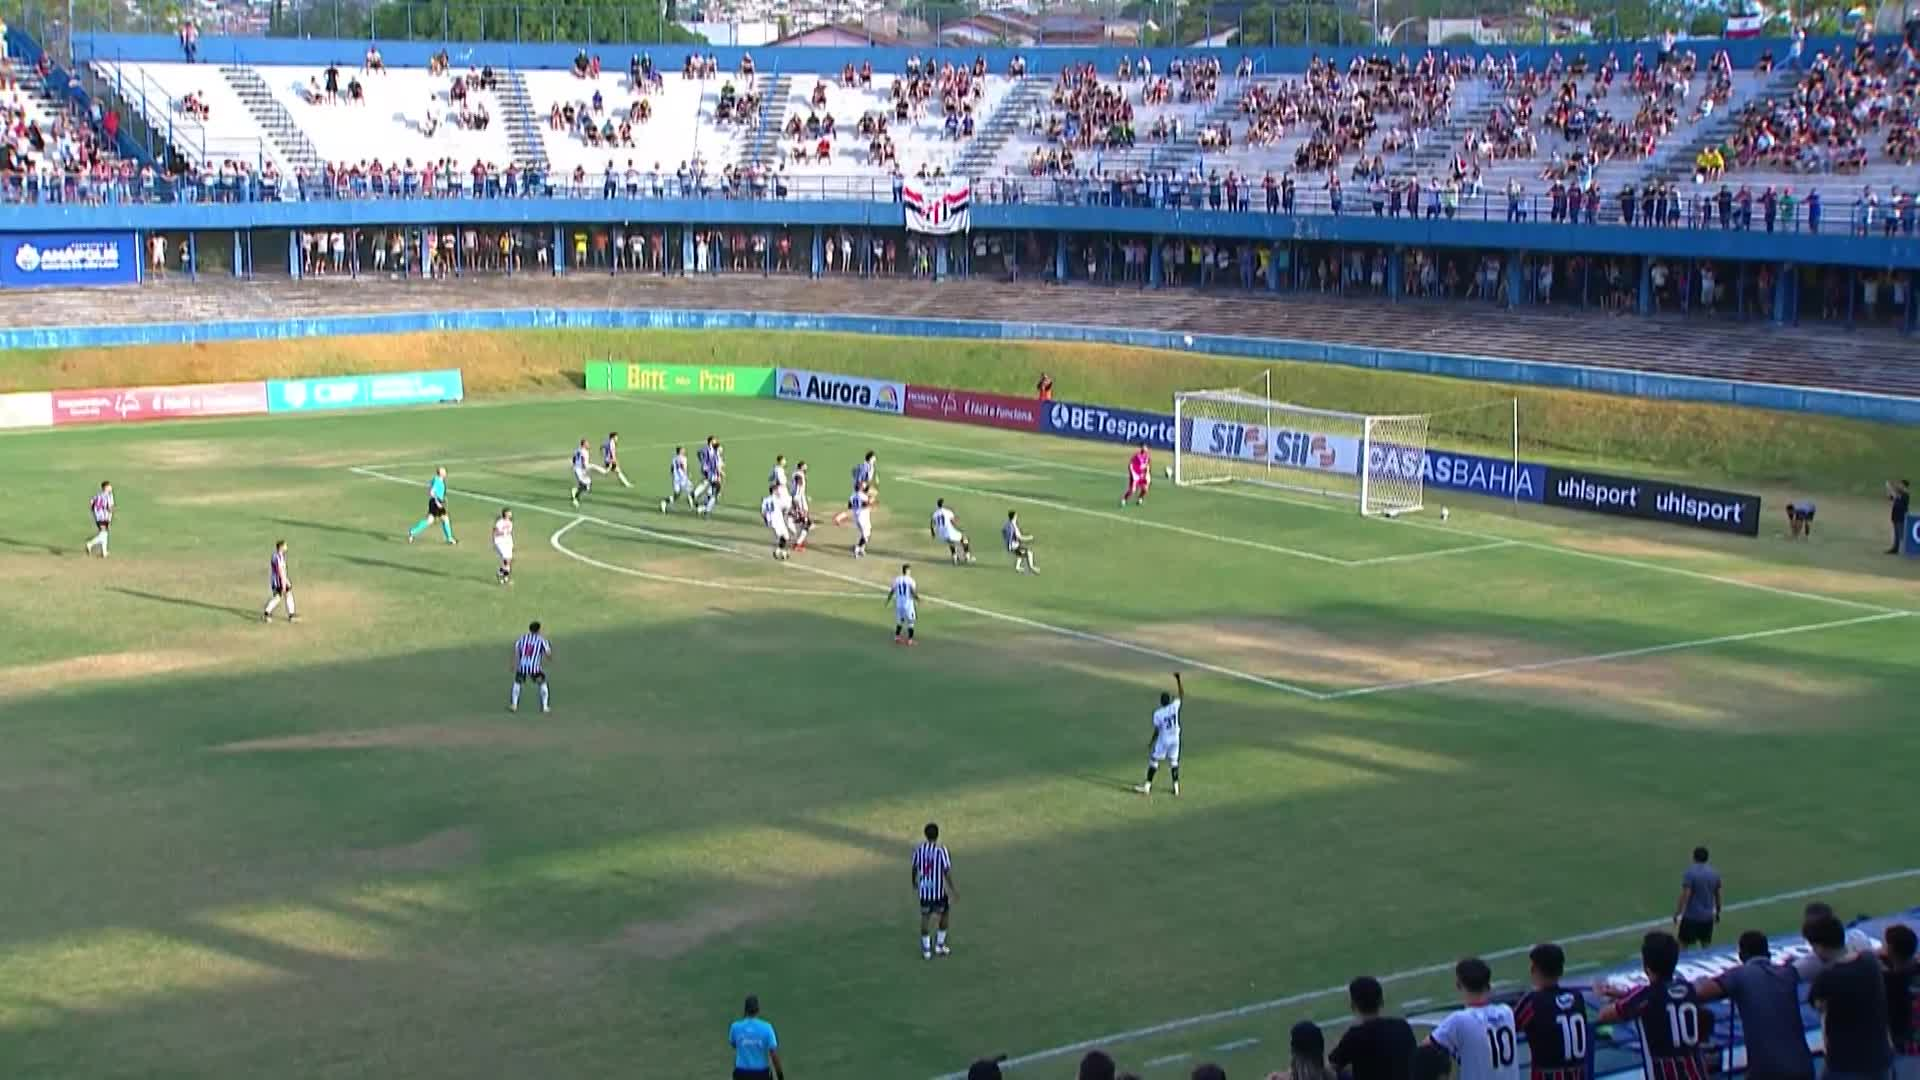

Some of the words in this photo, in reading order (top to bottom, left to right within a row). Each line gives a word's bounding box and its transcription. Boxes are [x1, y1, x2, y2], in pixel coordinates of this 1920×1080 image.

[806, 375, 871, 406] Aurora
[1071, 406, 1176, 442] BETesporte
[1209, 423, 1244, 456] Sil
[1274, 430, 1310, 466] Sil
[1557, 476, 1637, 507] uhlsport
[1656, 491, 1742, 523] uhlsport
[1555, 1013, 1587, 1061] 10
[1666, 1001, 1699, 1049] 10
[1486, 1025, 1515, 1070] 10
